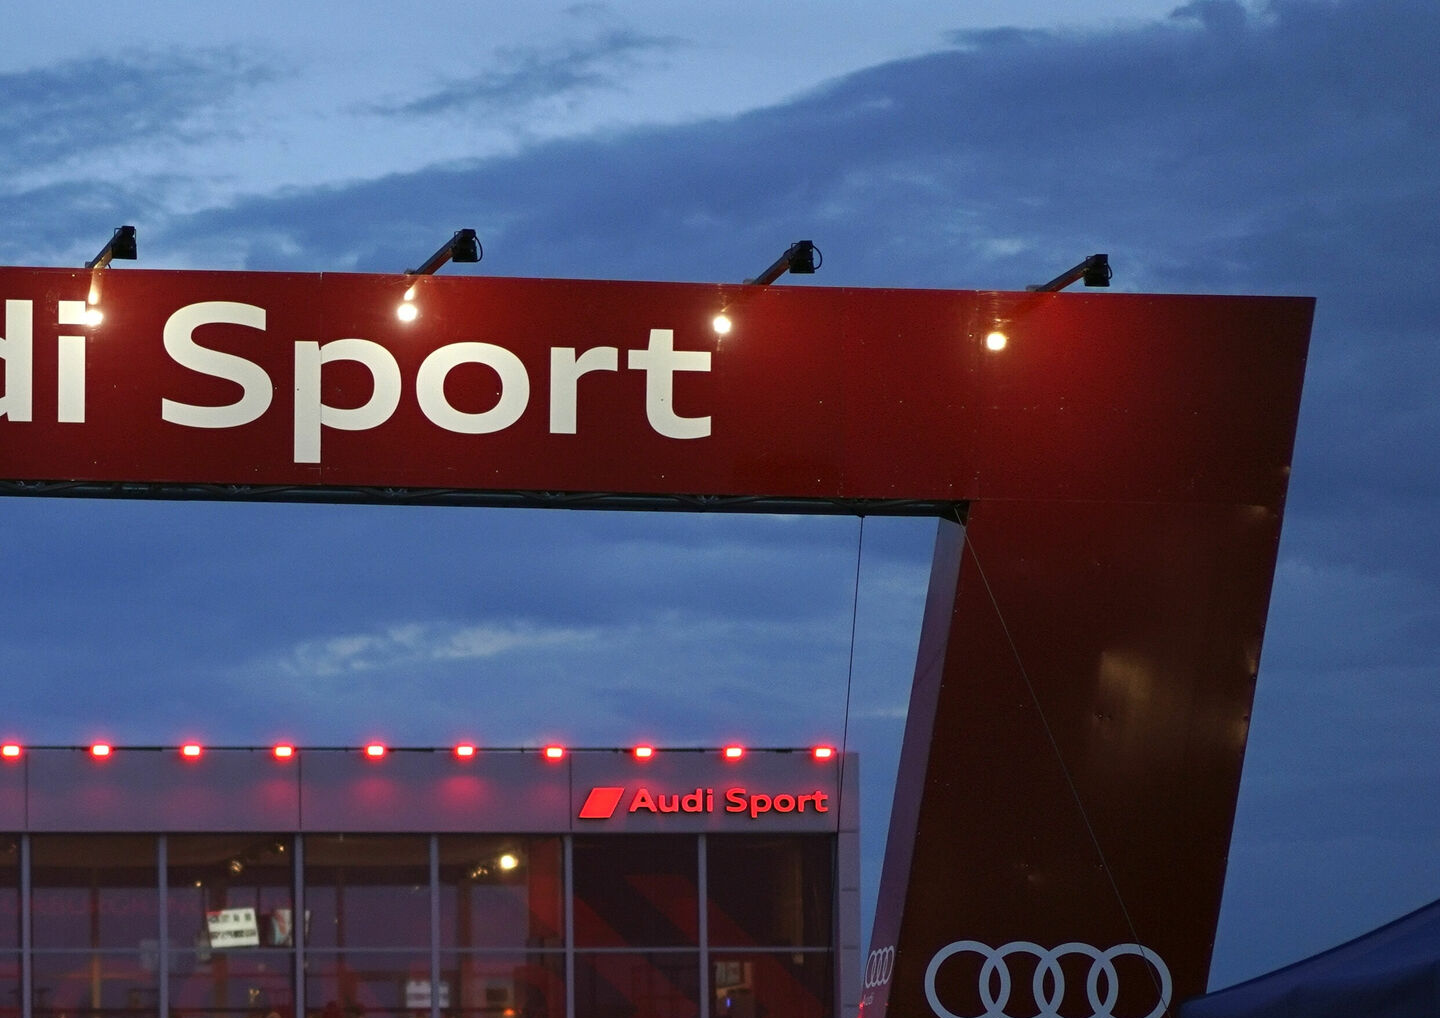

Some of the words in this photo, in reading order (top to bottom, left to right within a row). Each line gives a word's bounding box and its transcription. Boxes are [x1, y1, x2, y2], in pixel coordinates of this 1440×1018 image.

[161, 301, 713, 464] Sport
[627, 788, 714, 813] Audi
[725, 787, 829, 819] Sport
